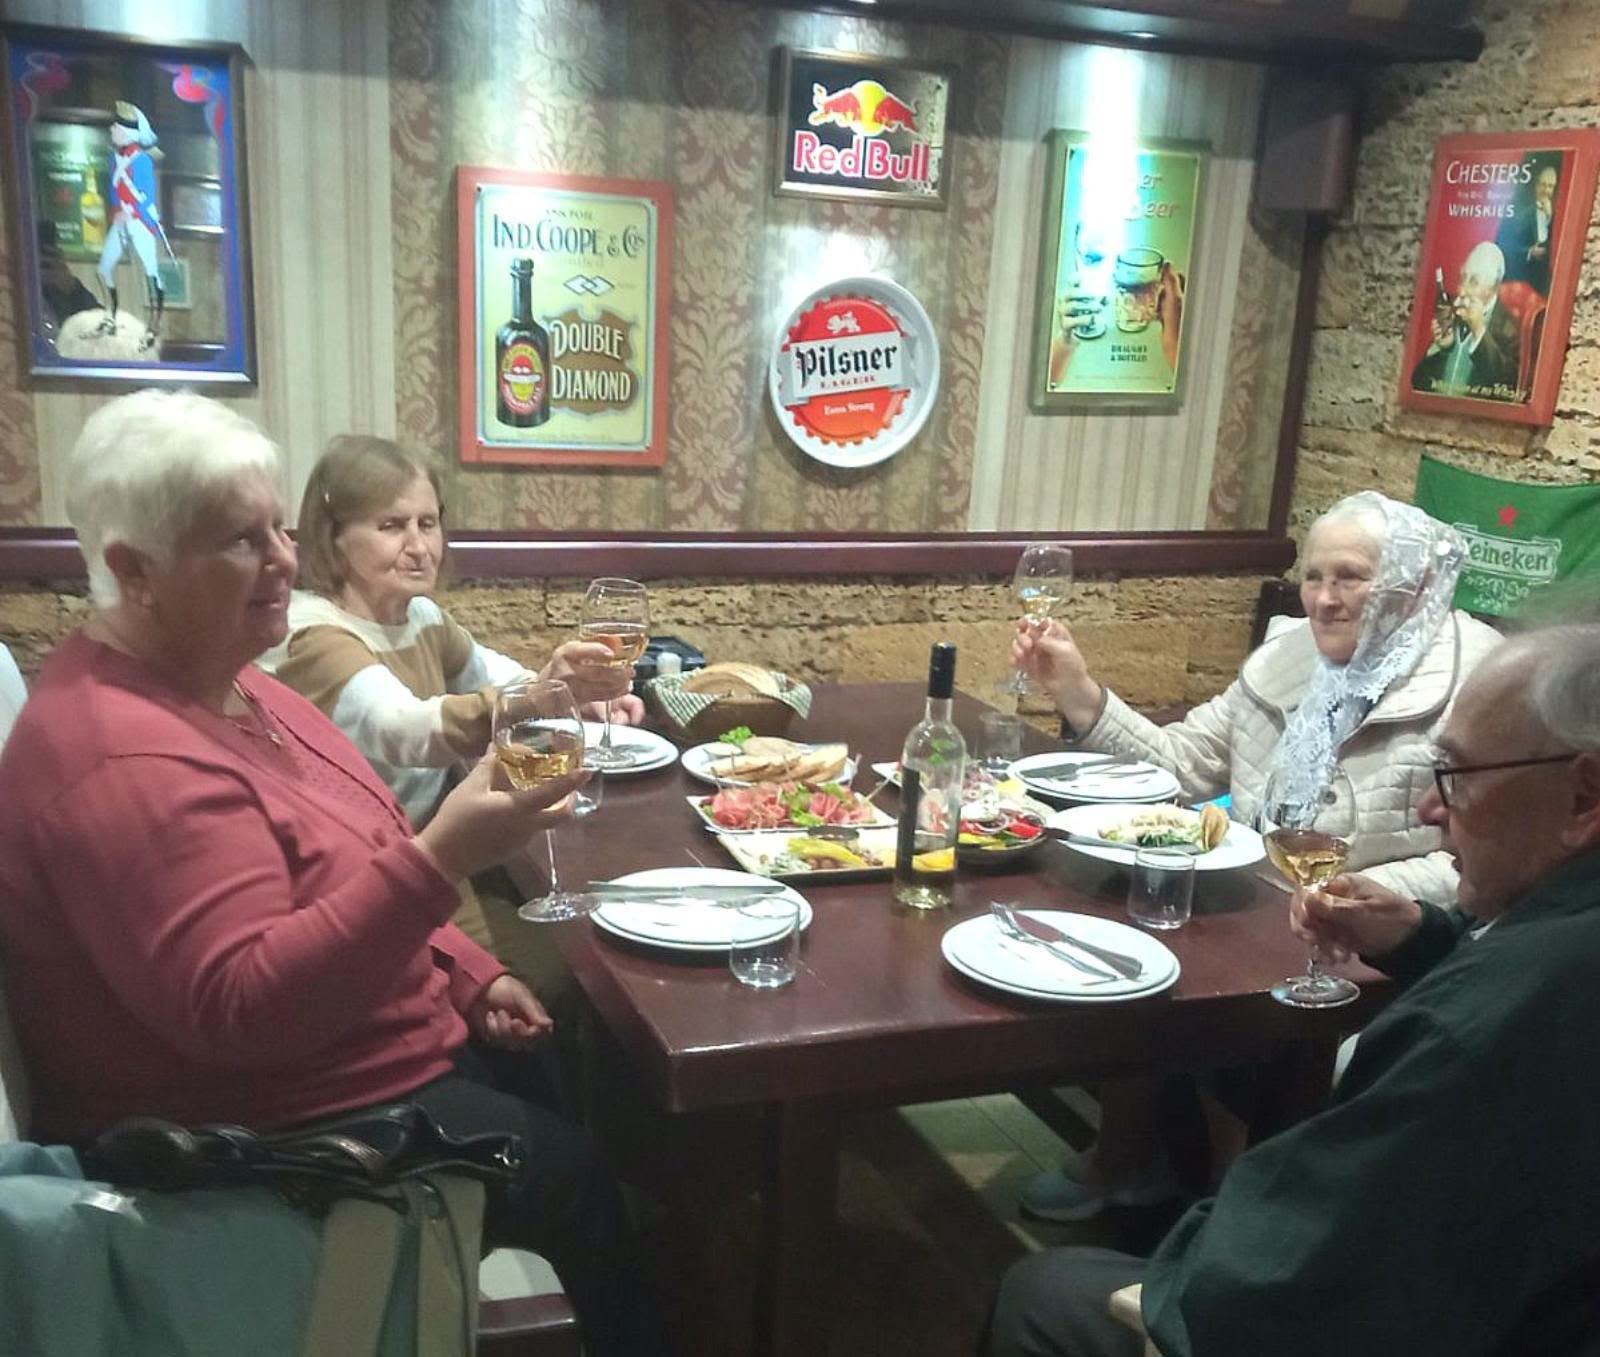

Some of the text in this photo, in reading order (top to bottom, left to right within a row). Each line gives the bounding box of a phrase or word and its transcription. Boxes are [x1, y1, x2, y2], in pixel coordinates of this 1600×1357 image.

[1448, 202, 1516, 218] WHISKIES
[607, 233, 620, 257] &
[550, 319, 625, 361] DOUBLE
[551, 364, 631, 402] DIAMOND
[795, 345, 898, 389] Pilsner
